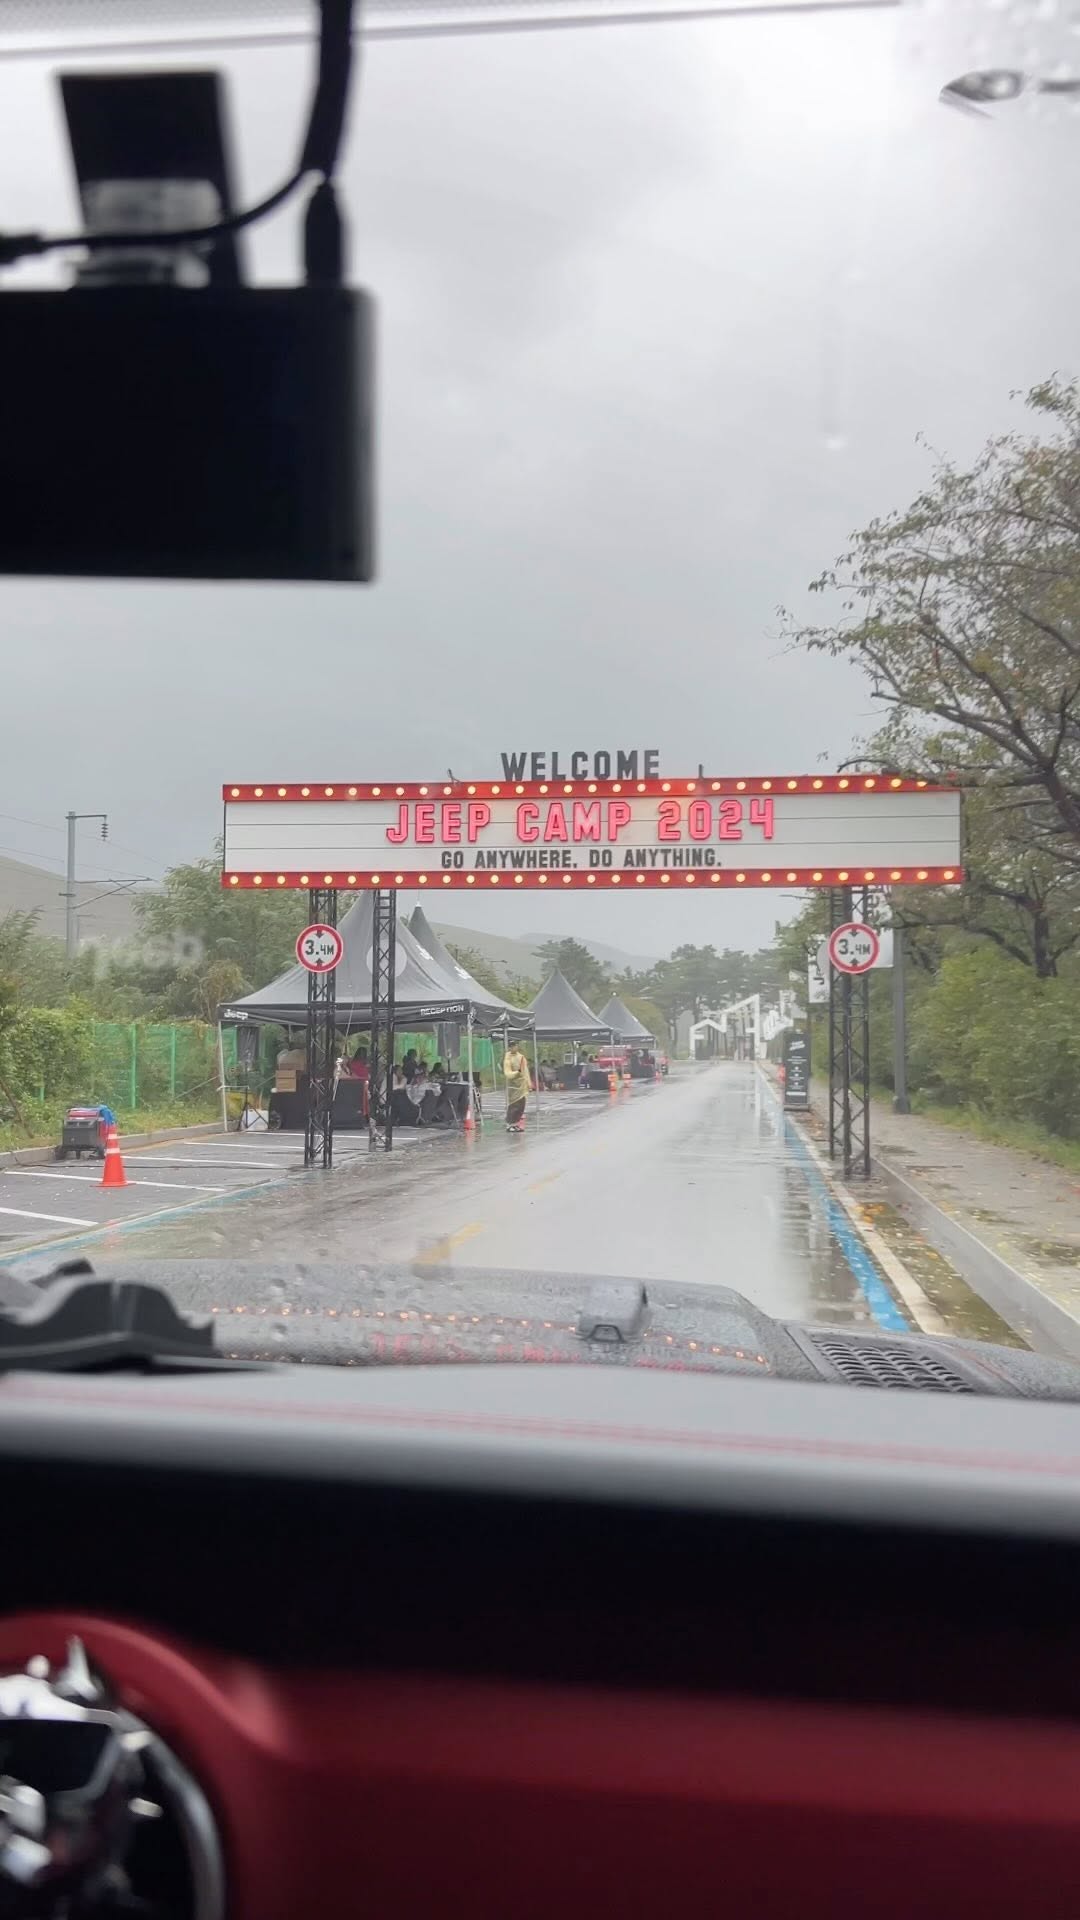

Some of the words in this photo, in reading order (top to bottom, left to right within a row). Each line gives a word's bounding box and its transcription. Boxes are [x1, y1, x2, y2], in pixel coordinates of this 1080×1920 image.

[500, 750, 660, 781] WELCOME
[386, 803, 491, 843] JEEP
[516, 801, 631, 842] CAMP
[658, 799, 774, 840] 2024
[441, 851, 464, 868] GO
[589, 849, 612, 867] DO
[624, 848, 722, 867] ANYTHING.
[420, 1005, 465, 1016] RECEPTION
